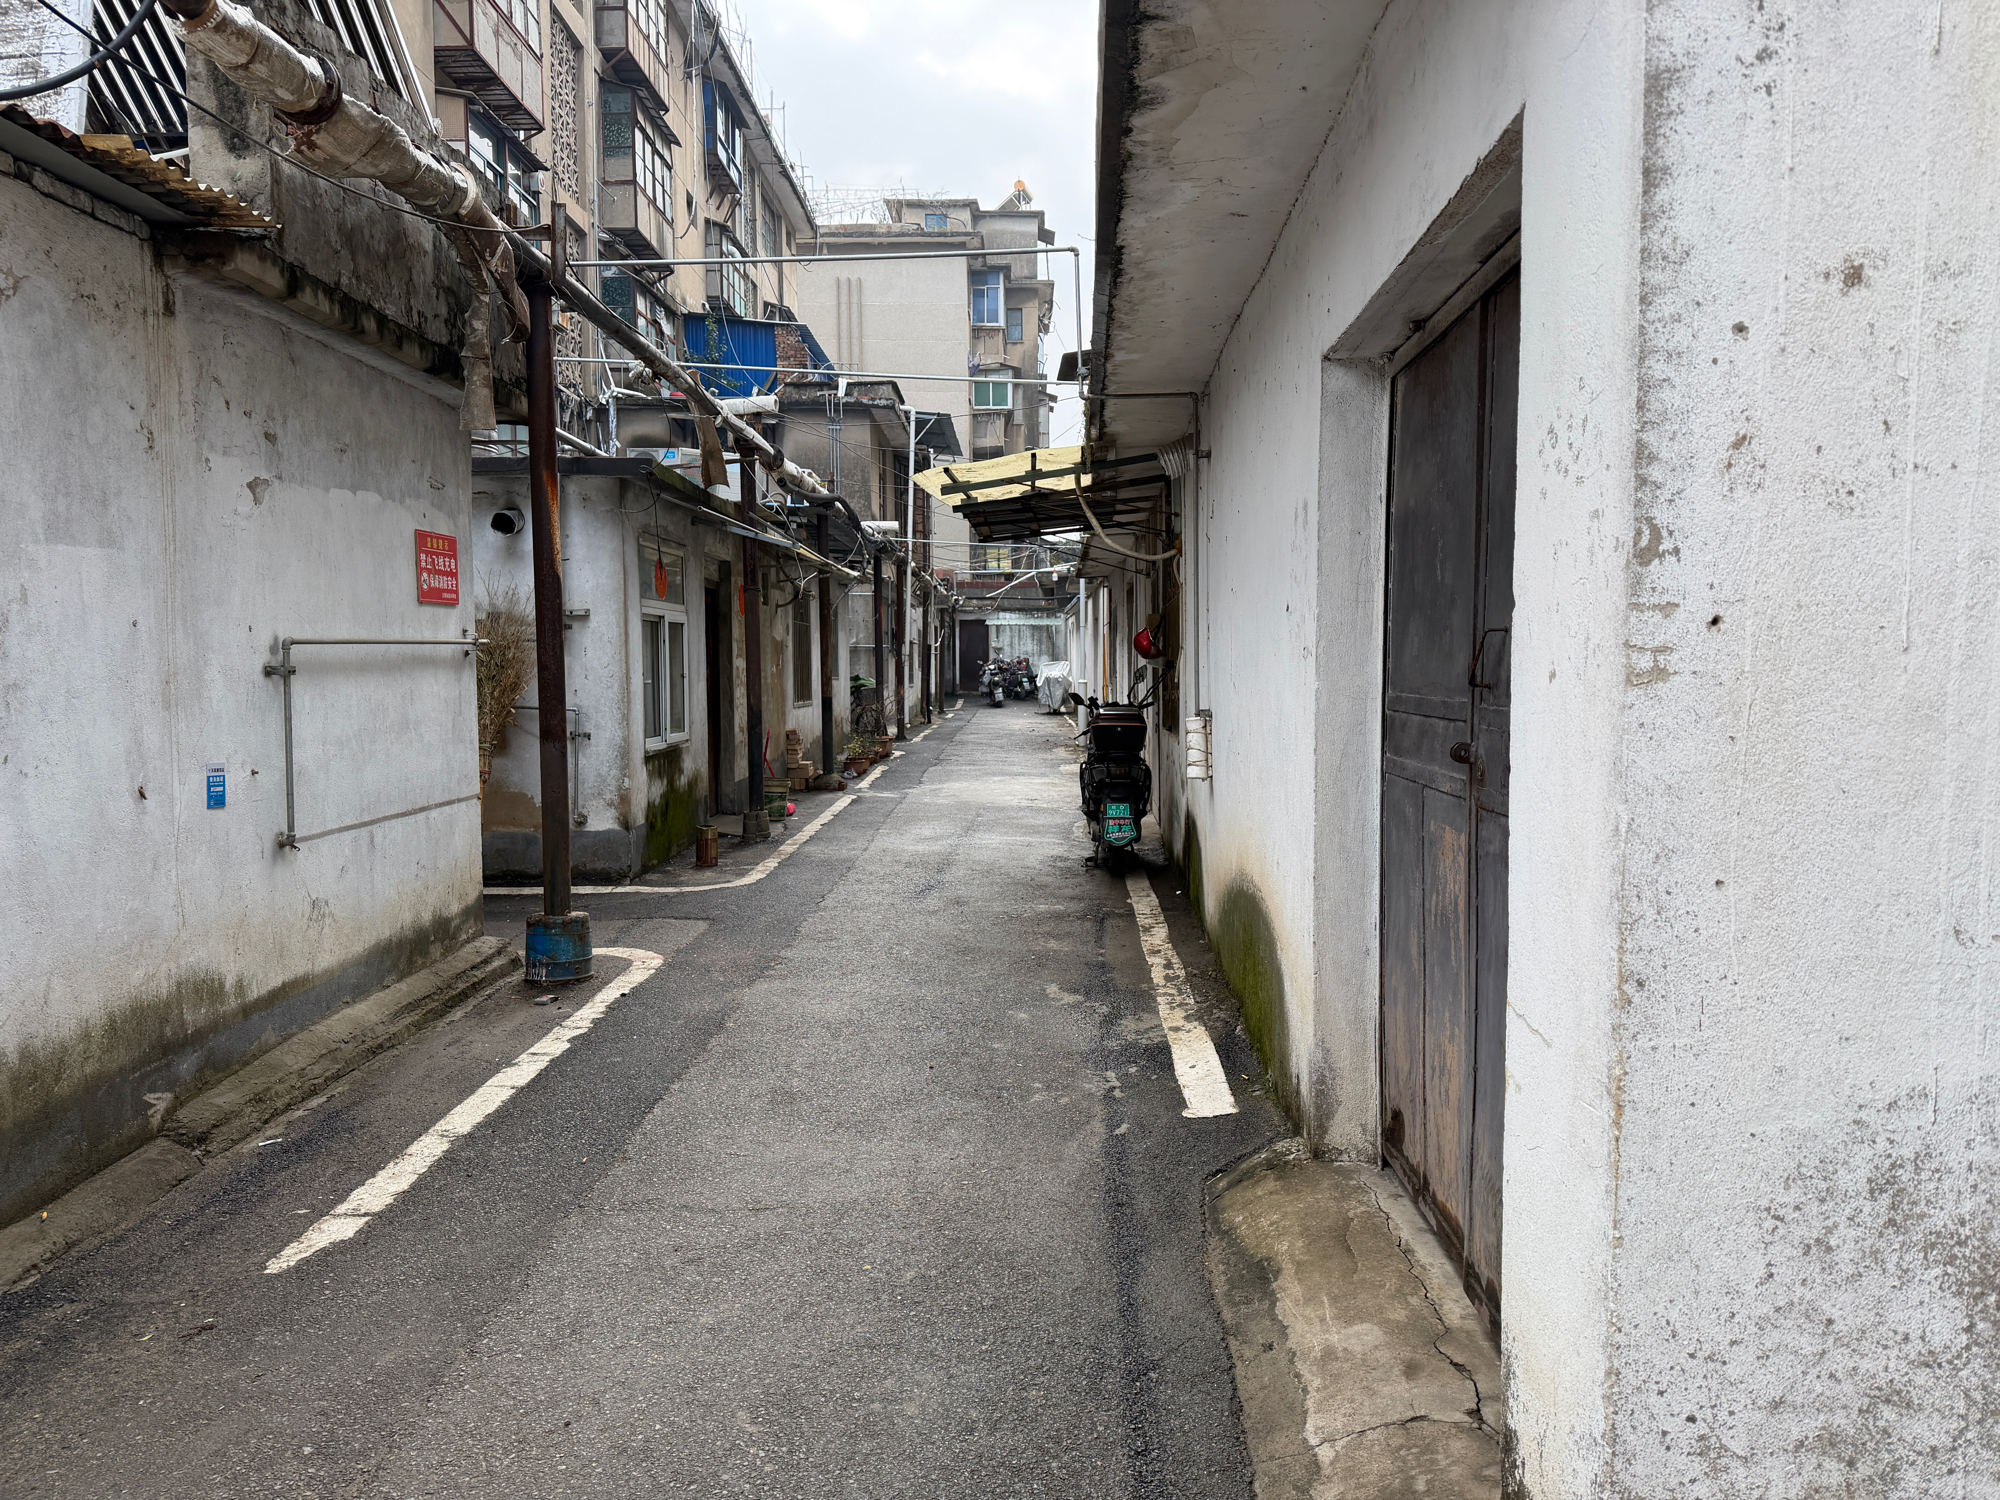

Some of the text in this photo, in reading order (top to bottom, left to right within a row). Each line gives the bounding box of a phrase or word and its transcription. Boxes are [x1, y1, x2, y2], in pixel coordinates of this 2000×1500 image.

[420, 552, 456, 573] 禁止飞线充电
